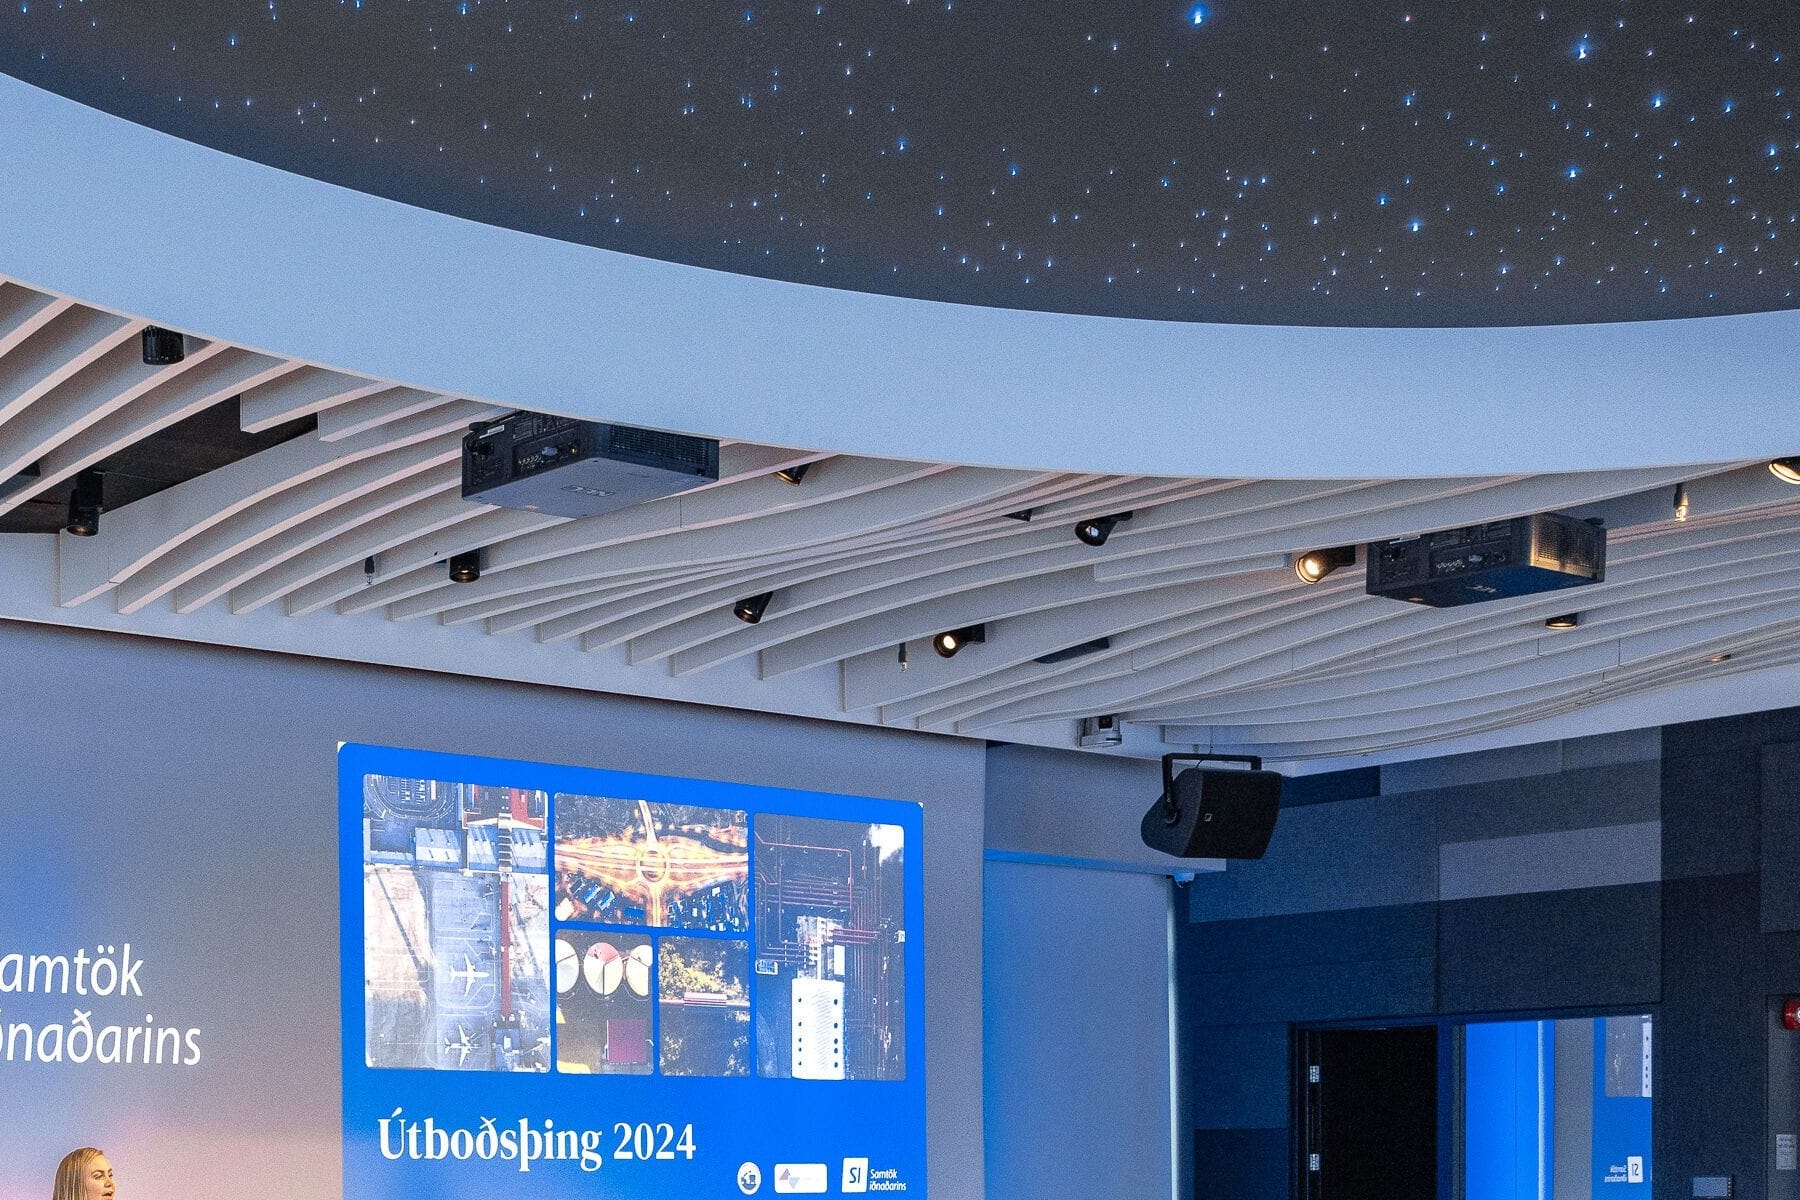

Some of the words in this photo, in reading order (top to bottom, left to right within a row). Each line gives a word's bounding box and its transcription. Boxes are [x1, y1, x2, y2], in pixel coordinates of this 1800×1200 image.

[377, 1107, 603, 1172] Útboðsþing
[613, 1122, 697, 1161] 2024
[848, 1166, 861, 1184] SI
[870, 1168, 898, 1179] Samtök
[869, 1180, 907, 1191] iðnaðarins
